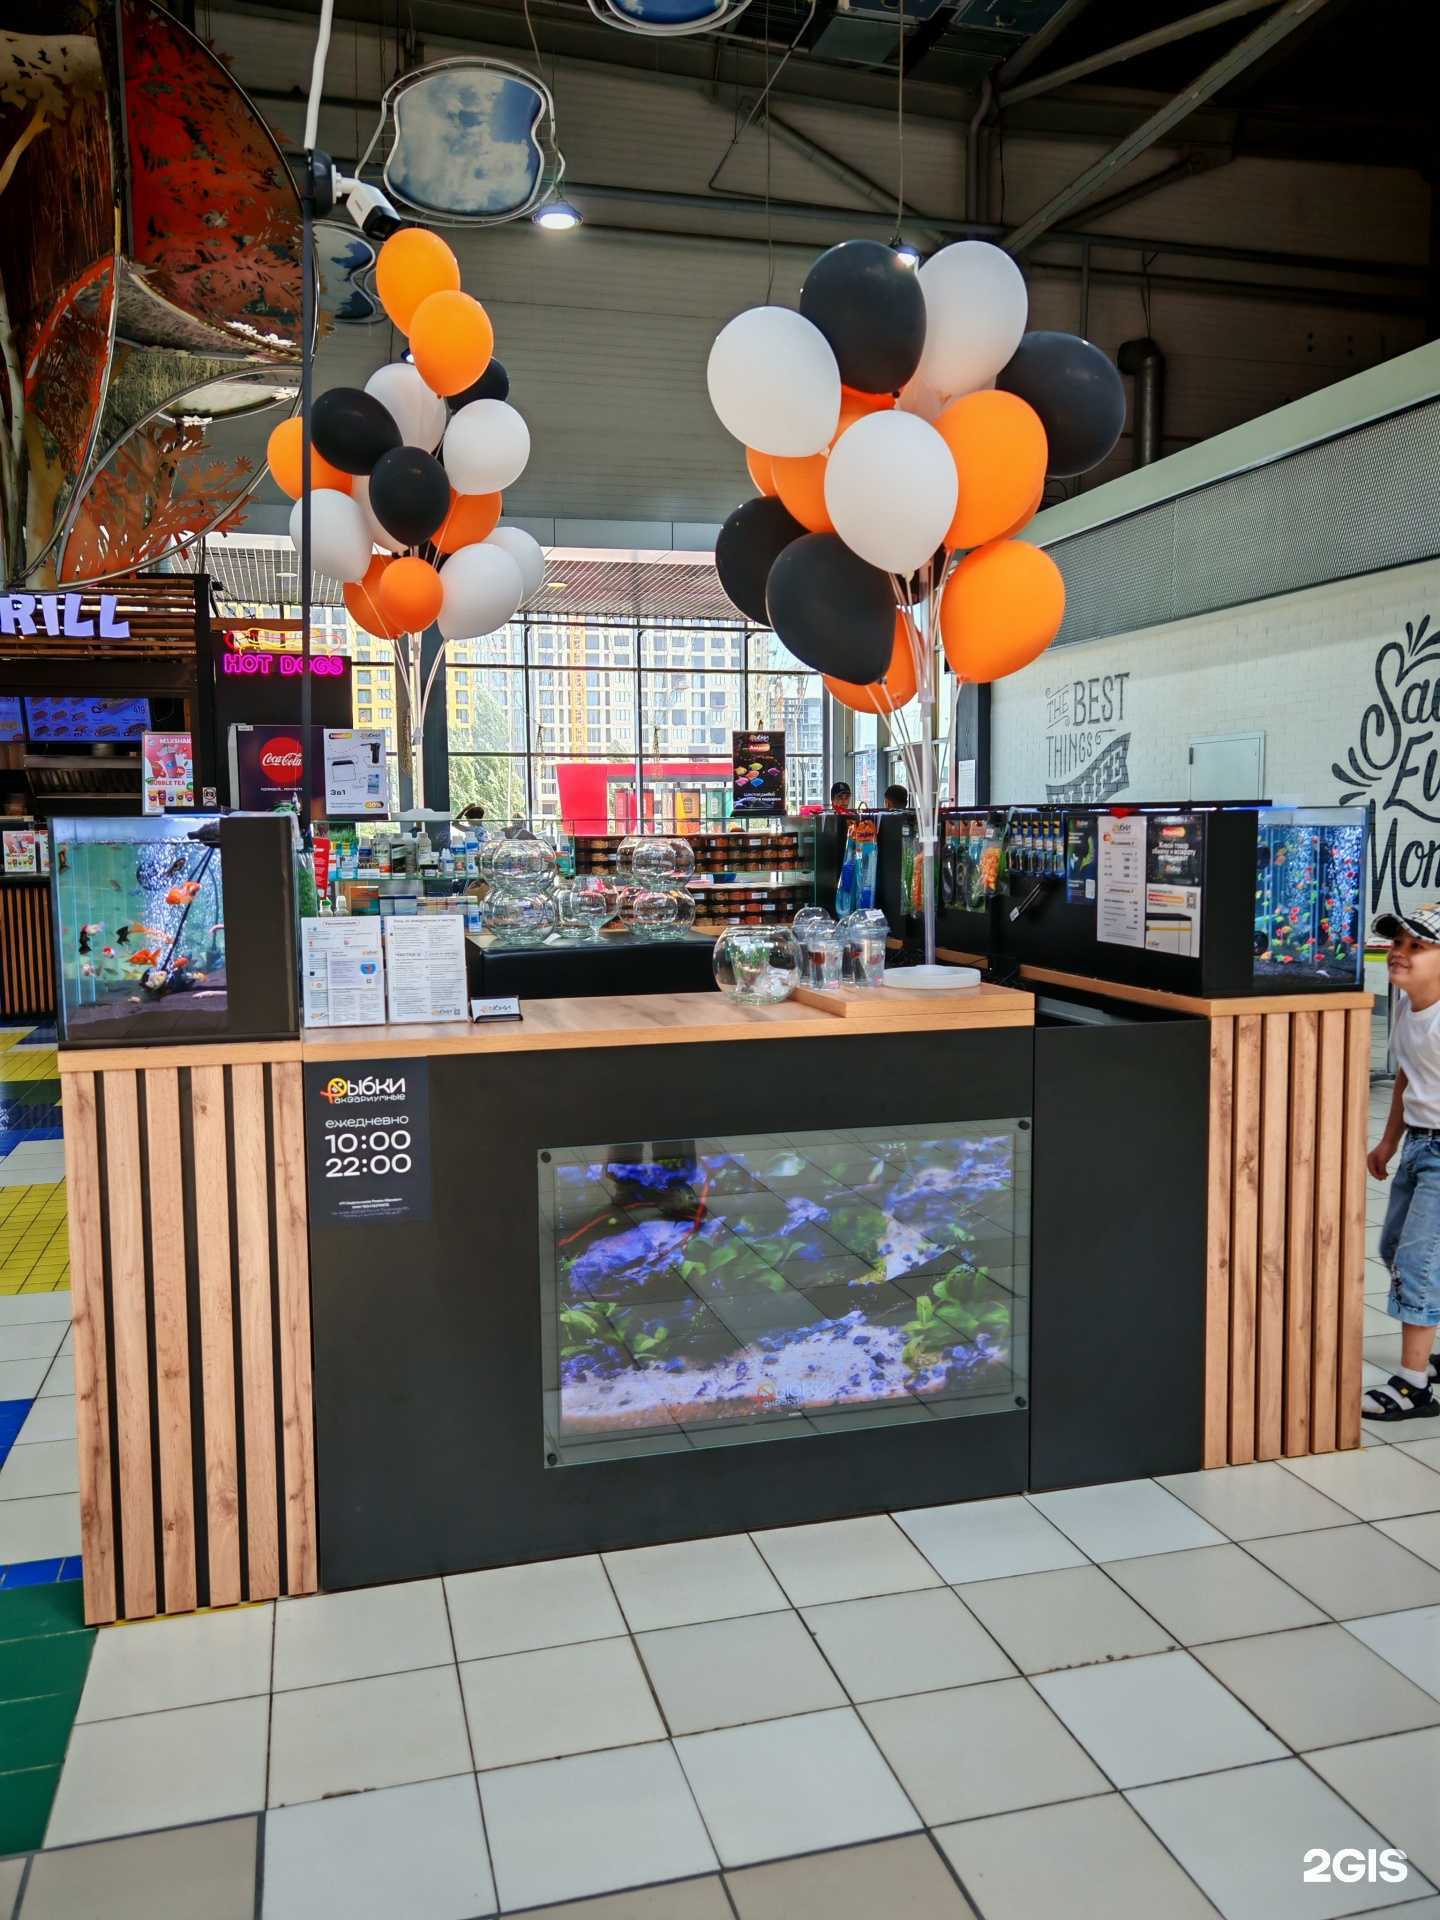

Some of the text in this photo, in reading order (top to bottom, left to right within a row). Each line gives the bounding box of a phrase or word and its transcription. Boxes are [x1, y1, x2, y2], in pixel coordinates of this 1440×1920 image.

[0, 593, 130, 639] RILL
[224, 654, 273, 673] HOT
[1047, 672, 1130, 726] THE BEST
[1046, 731, 1093, 778] THINGS
[334, 1093, 406, 1104] аквариумные
[325, 1115, 409, 1128] ежедневно
[324, 1130, 411, 1153] 10:00
[325, 1153, 412, 1178] 22:00
